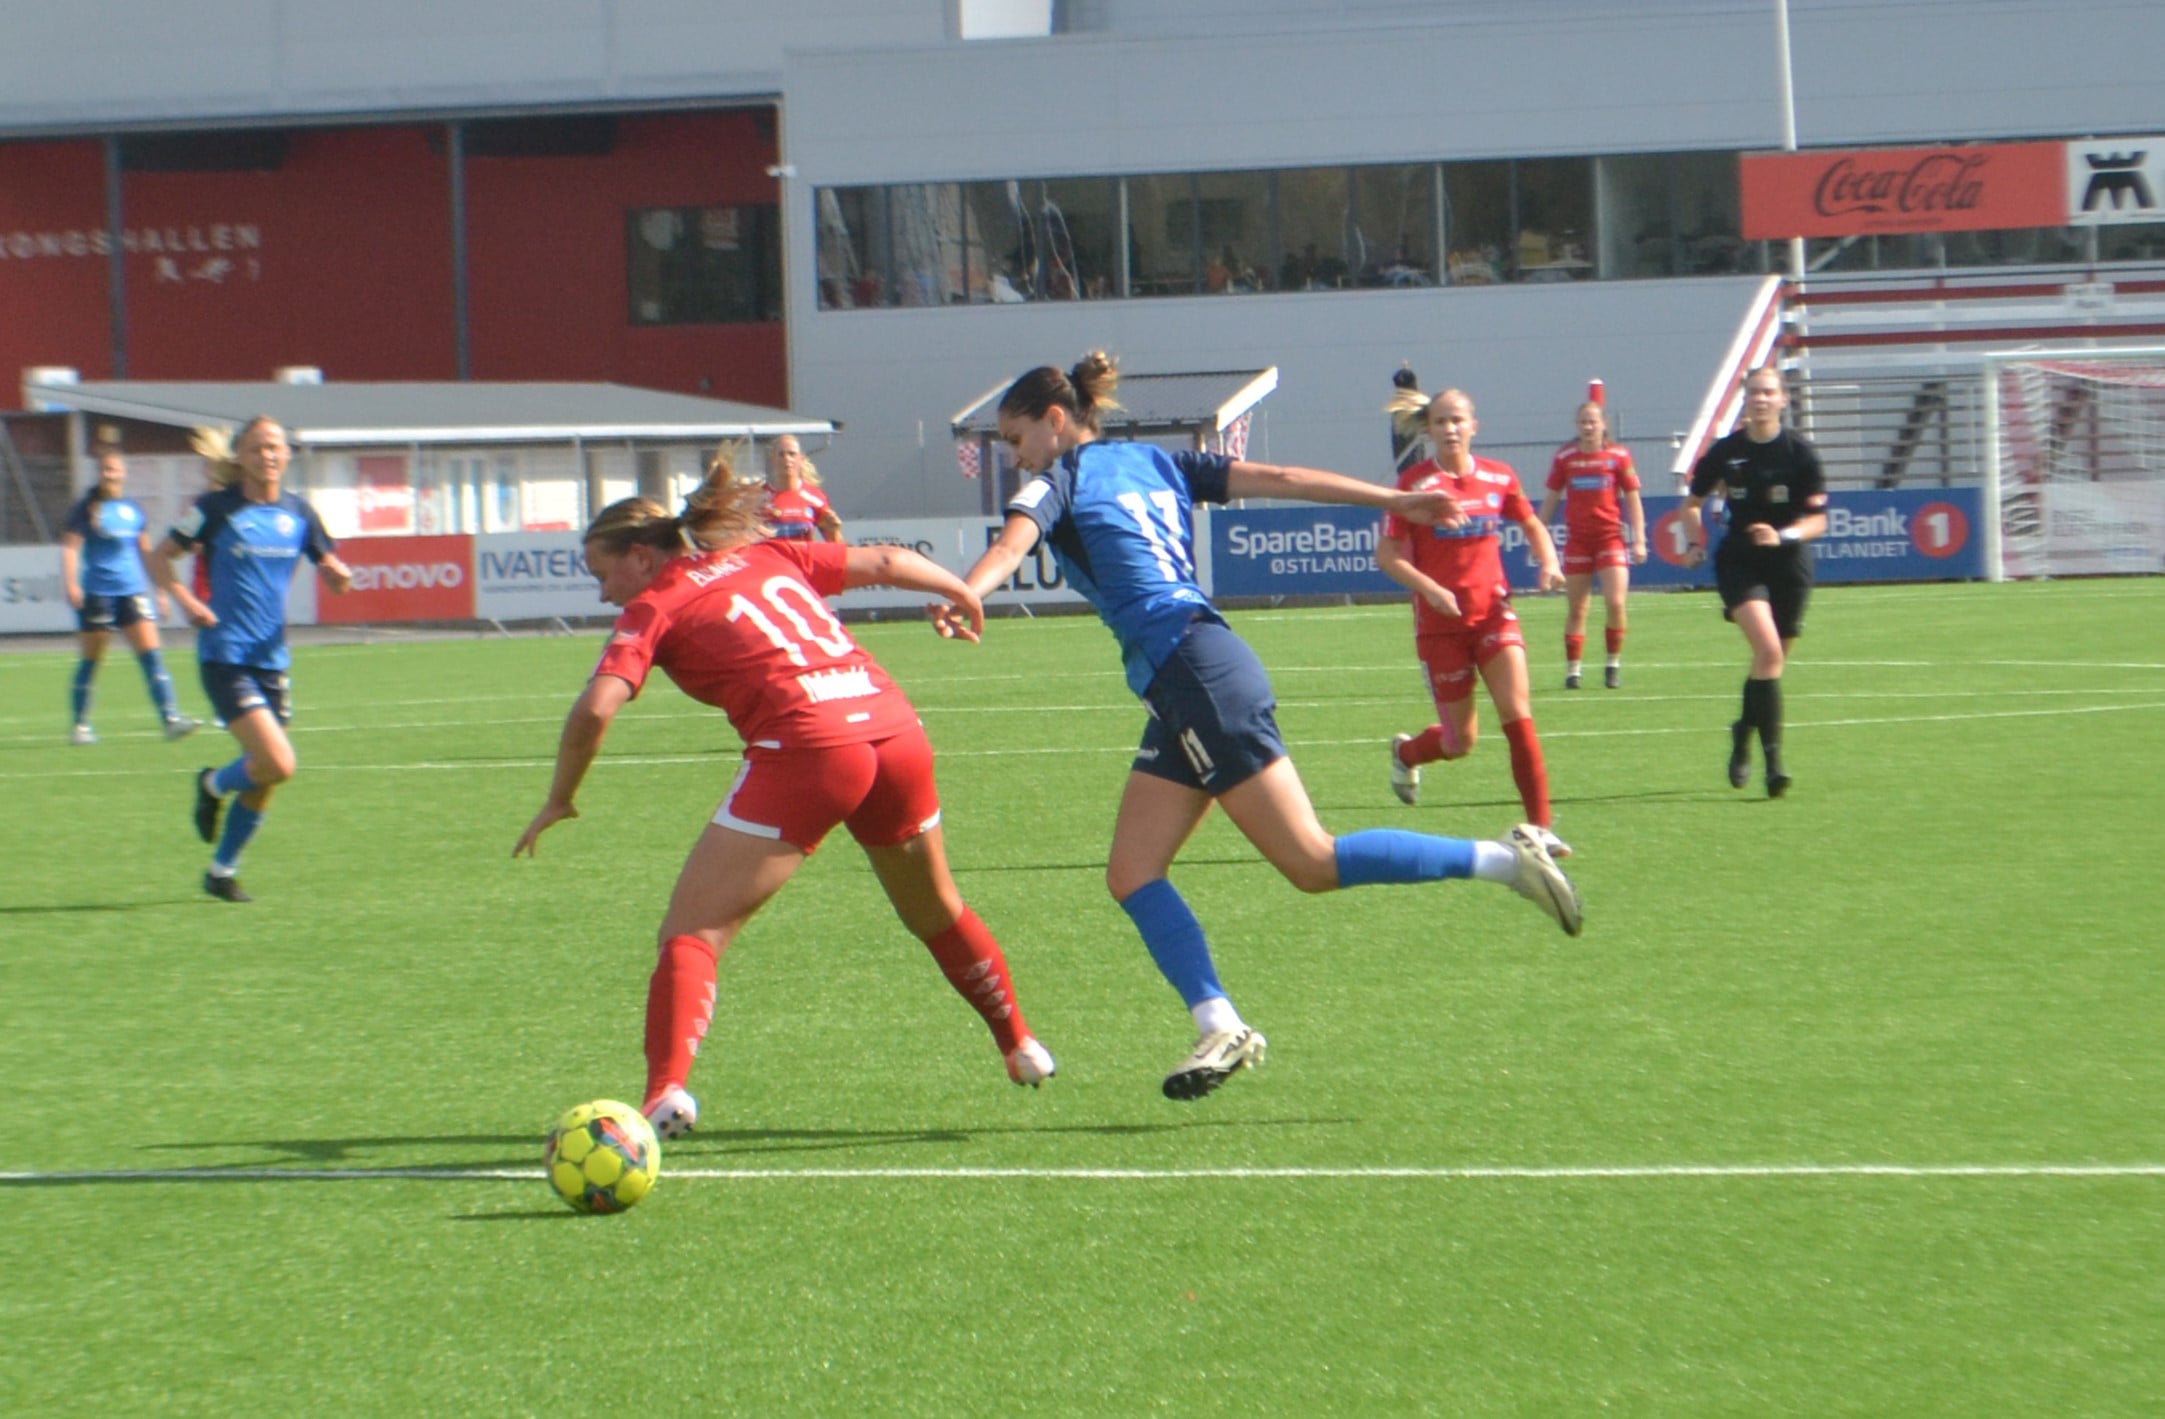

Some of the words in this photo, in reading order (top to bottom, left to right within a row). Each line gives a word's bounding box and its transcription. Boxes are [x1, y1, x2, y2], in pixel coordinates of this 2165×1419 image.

[1116, 489, 1194, 582] 11
[1926, 512, 1949, 548] 1
[351, 562, 462, 591] enovo
[1270, 556, 1381, 575] ØSTLANDE
[725, 575, 855, 667] 10
